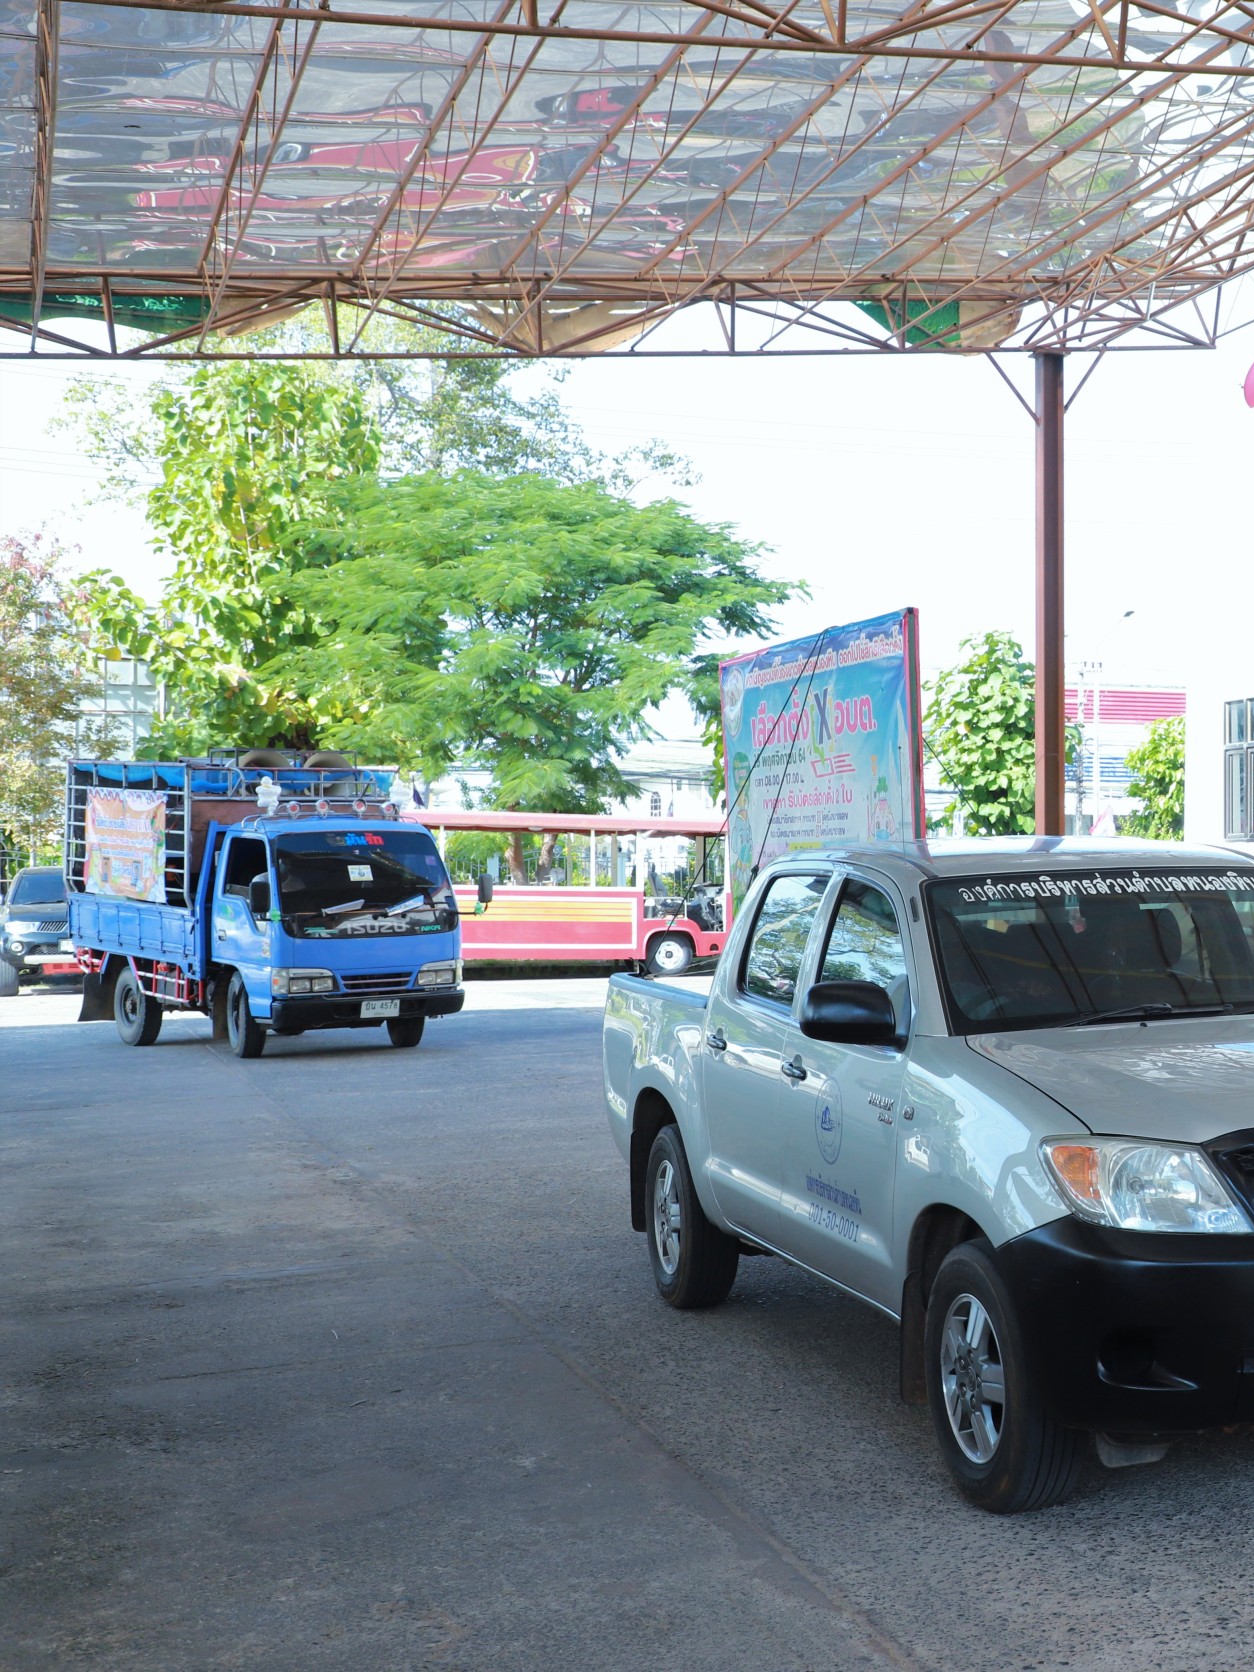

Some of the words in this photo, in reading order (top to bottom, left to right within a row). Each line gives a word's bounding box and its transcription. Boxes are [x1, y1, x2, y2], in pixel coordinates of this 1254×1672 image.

[833, 696, 877, 736] อบต.
[347, 922, 408, 935] ISUZU
[808, 1202, 860, 1244] 001-50-0001
